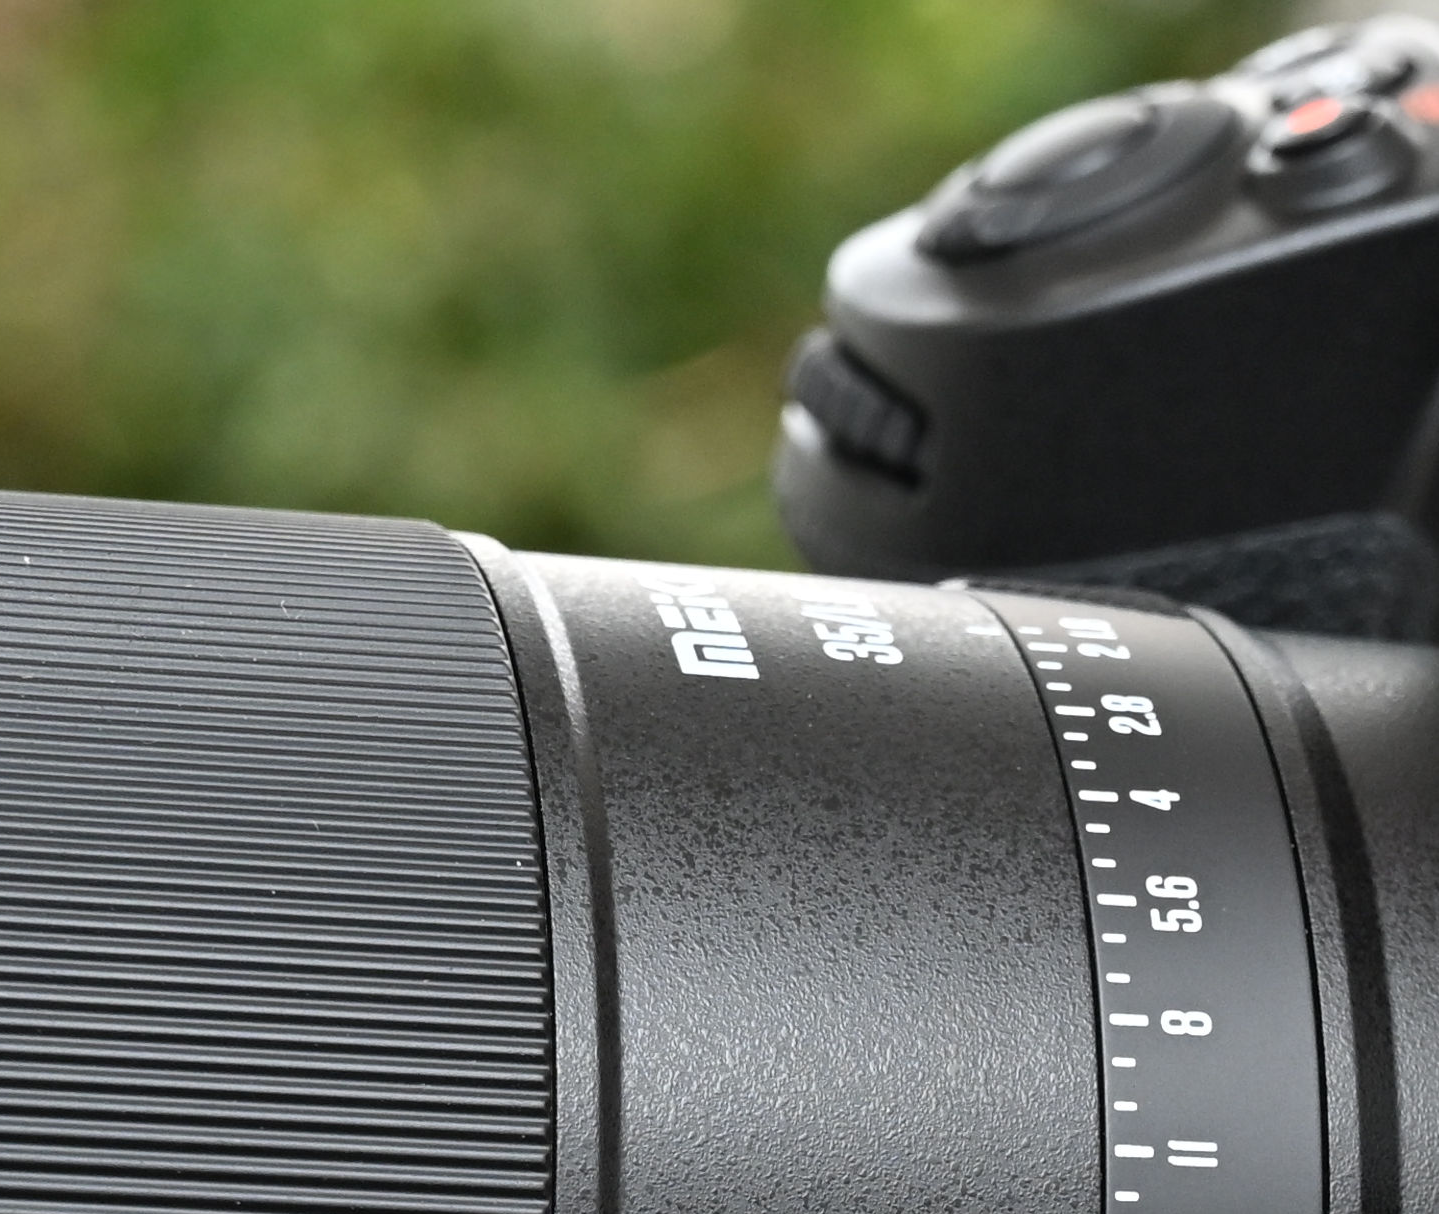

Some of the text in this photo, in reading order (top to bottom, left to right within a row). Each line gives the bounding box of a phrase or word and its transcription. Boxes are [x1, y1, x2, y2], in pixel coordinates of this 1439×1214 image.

[1100, 694, 1163, 736] 2.8
[1129, 788, 1181, 812] 4
[1145, 874, 1203, 933] 5.6
[1160, 1009, 1213, 1037] 8
[1167, 1139, 1219, 1168] 11
